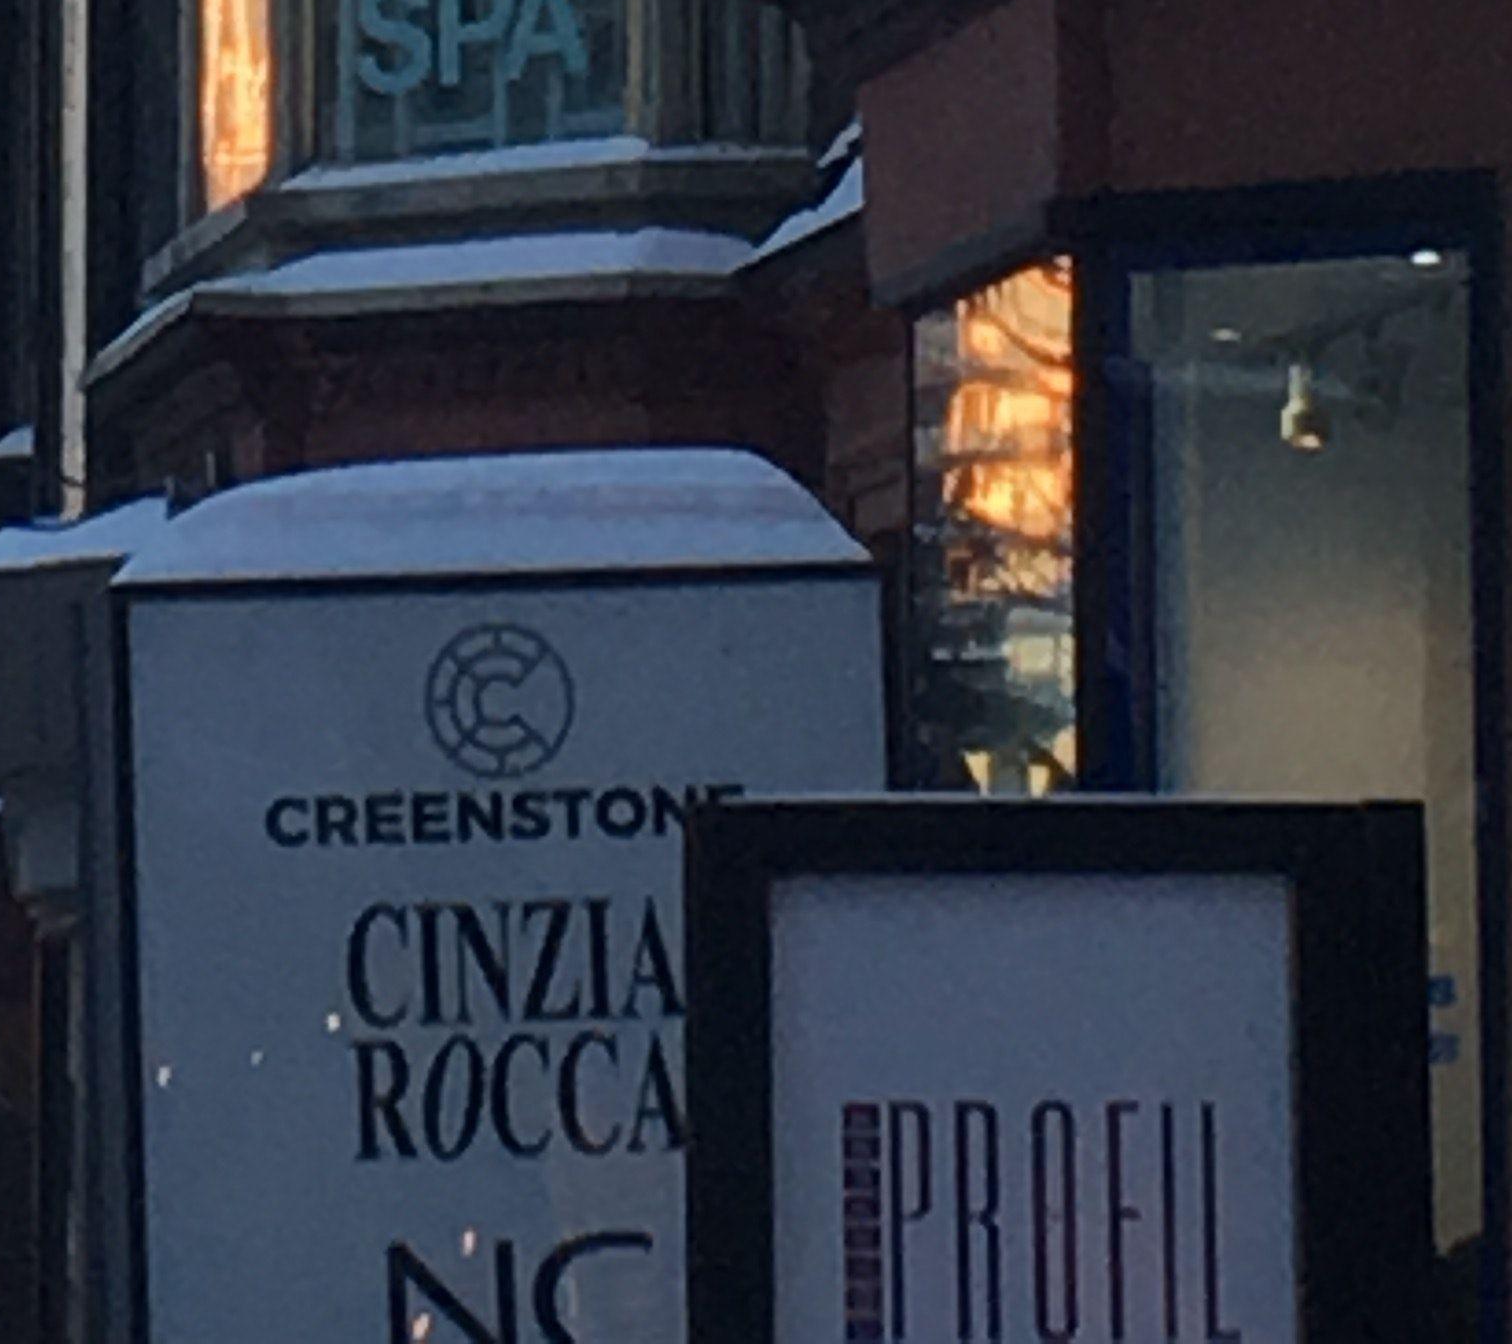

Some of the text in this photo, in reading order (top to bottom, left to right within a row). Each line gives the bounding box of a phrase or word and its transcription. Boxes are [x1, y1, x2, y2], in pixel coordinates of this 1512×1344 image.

[346, 896, 687, 1030] CINZIA
[351, 1030, 687, 1163] ROCCA
[888, 1099, 1243, 1341] PROFIL
